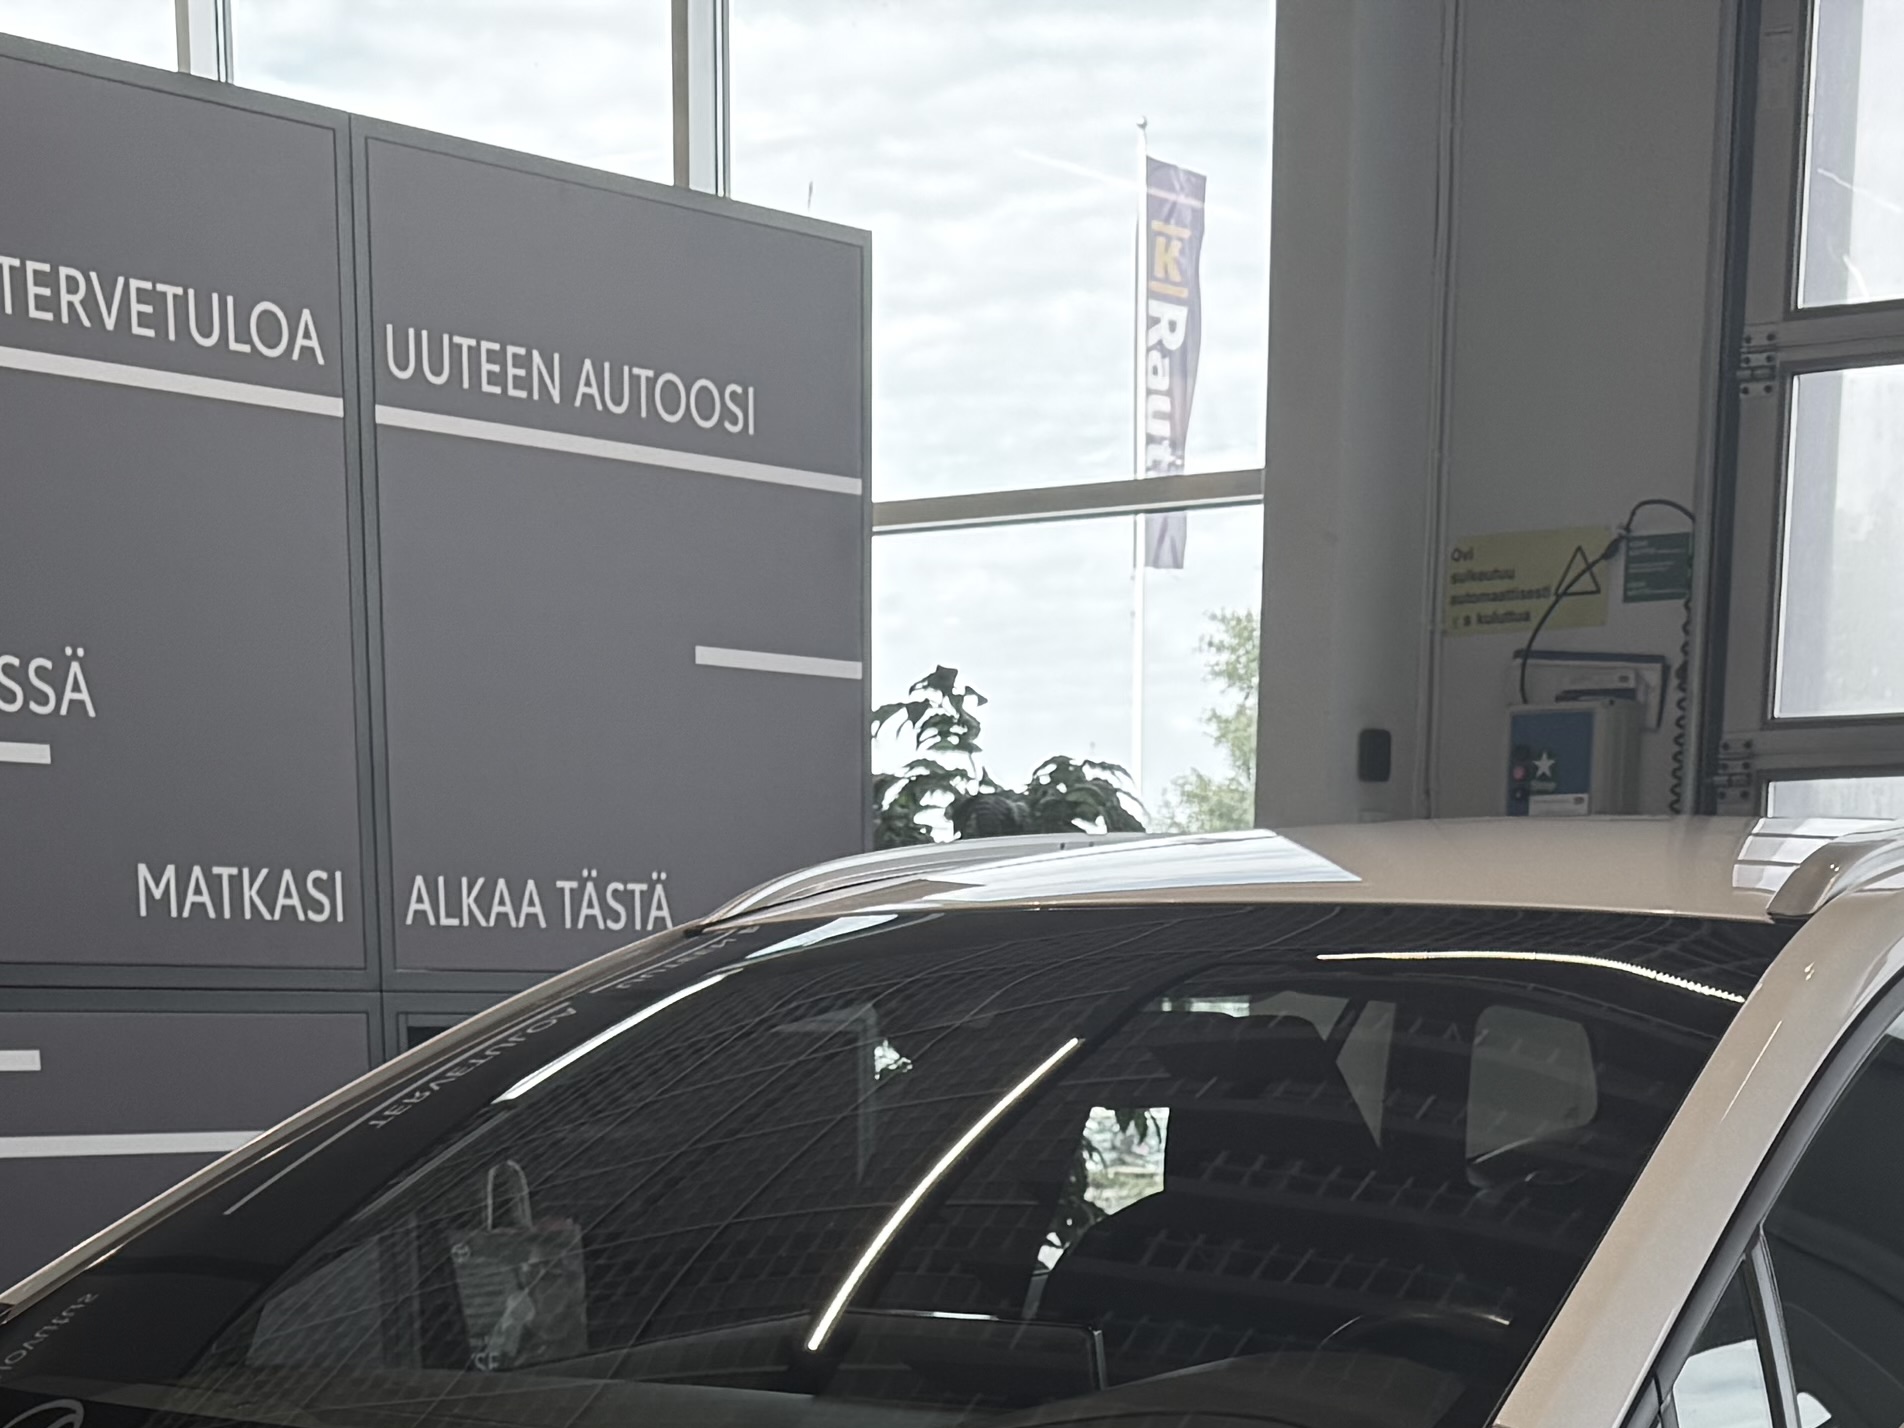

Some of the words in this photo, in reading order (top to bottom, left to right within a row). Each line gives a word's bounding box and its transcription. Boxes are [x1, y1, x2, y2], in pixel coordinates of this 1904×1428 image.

[386, 323, 561, 404] UUTEEN
[574, 358, 756, 436] AUTOOSI
[137, 863, 344, 923] MATKASI
[405, 875, 546, 930] ALKAA
[555, 868, 674, 932] TÄSTÄ
